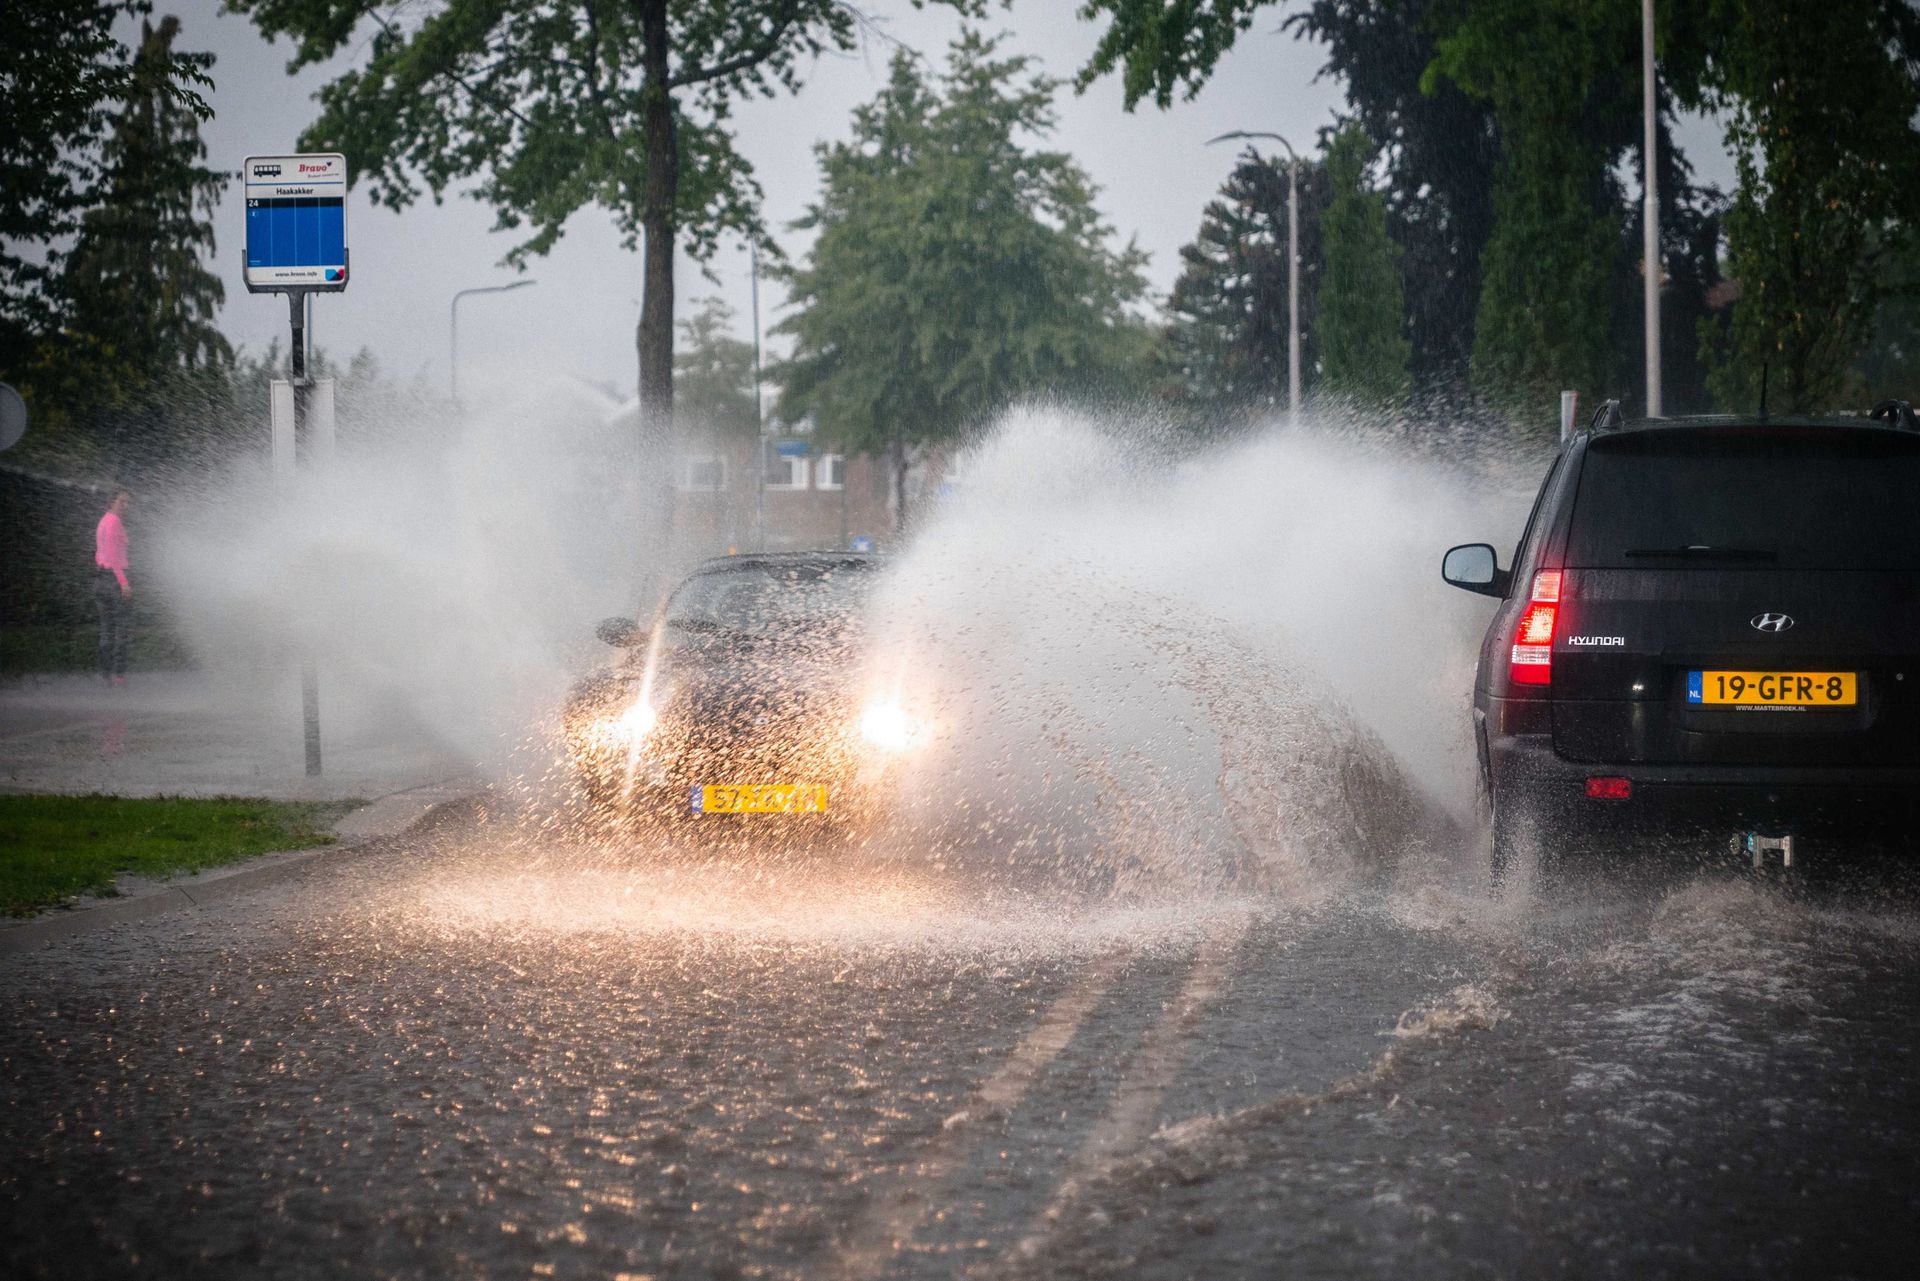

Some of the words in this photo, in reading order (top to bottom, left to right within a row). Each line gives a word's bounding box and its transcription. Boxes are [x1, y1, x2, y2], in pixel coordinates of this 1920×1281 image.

[298, 164, 327, 172] Bravo
[276, 187, 314, 195] Haakakker
[248, 199, 259, 207] 24
[1568, 636, 1625, 646] HYUNDAI
[1717, 676, 1843, 700] 19-GFR-8
[1689, 690, 1701, 698] NL
